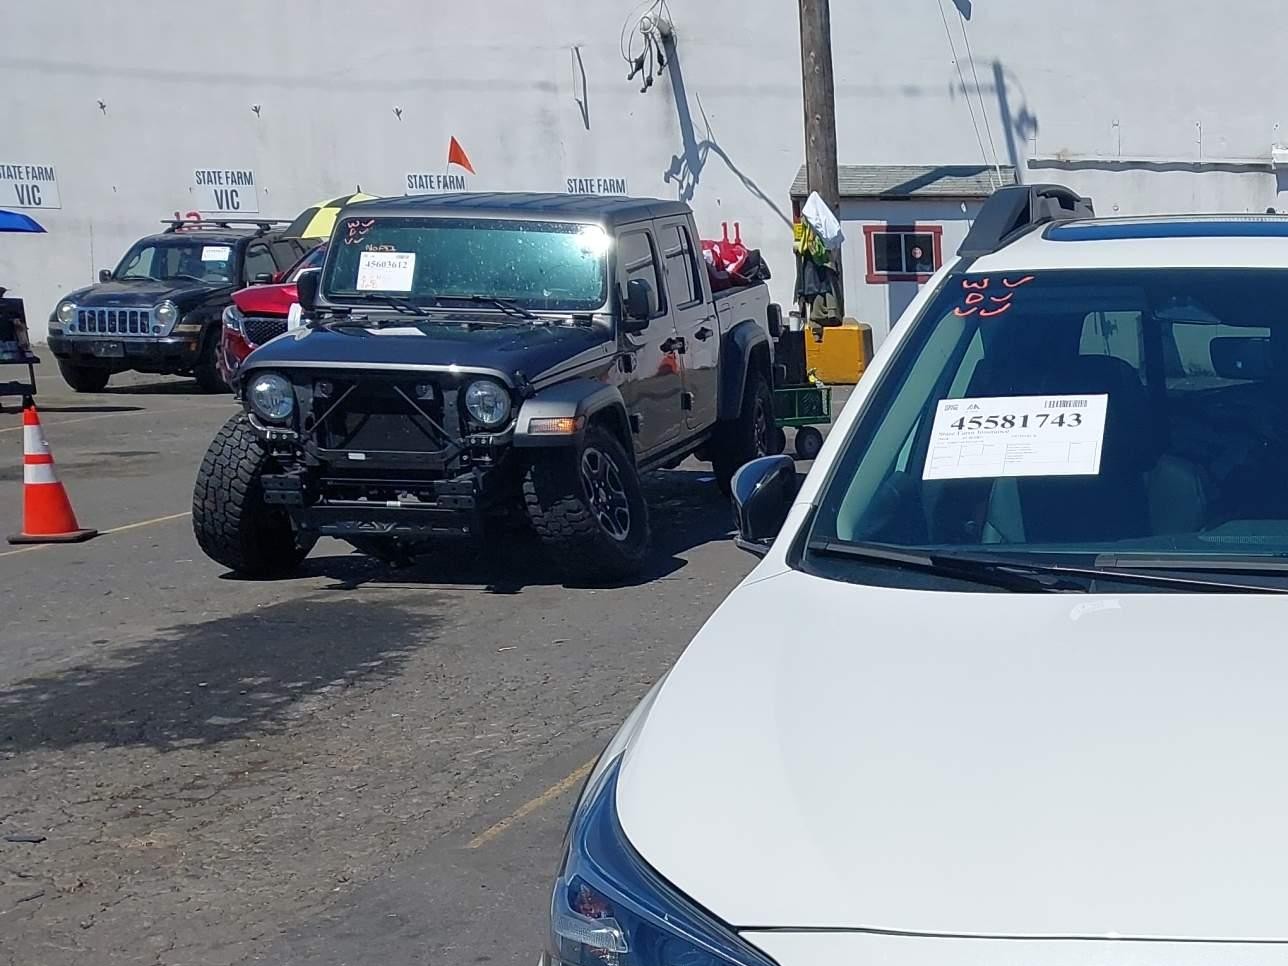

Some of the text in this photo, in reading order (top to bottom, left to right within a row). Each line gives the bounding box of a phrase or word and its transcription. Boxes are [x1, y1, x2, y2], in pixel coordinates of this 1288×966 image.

[0, 164, 55, 181] TATE FARM
[195, 170, 254, 186] STATE FARM
[407, 174, 465, 190] STATE FARM
[567, 178, 626, 194] STATE FARM
[14, 183, 42, 206] VIC
[214, 188, 240, 210] VIC
[950, 412, 1083, 431] 45581743
